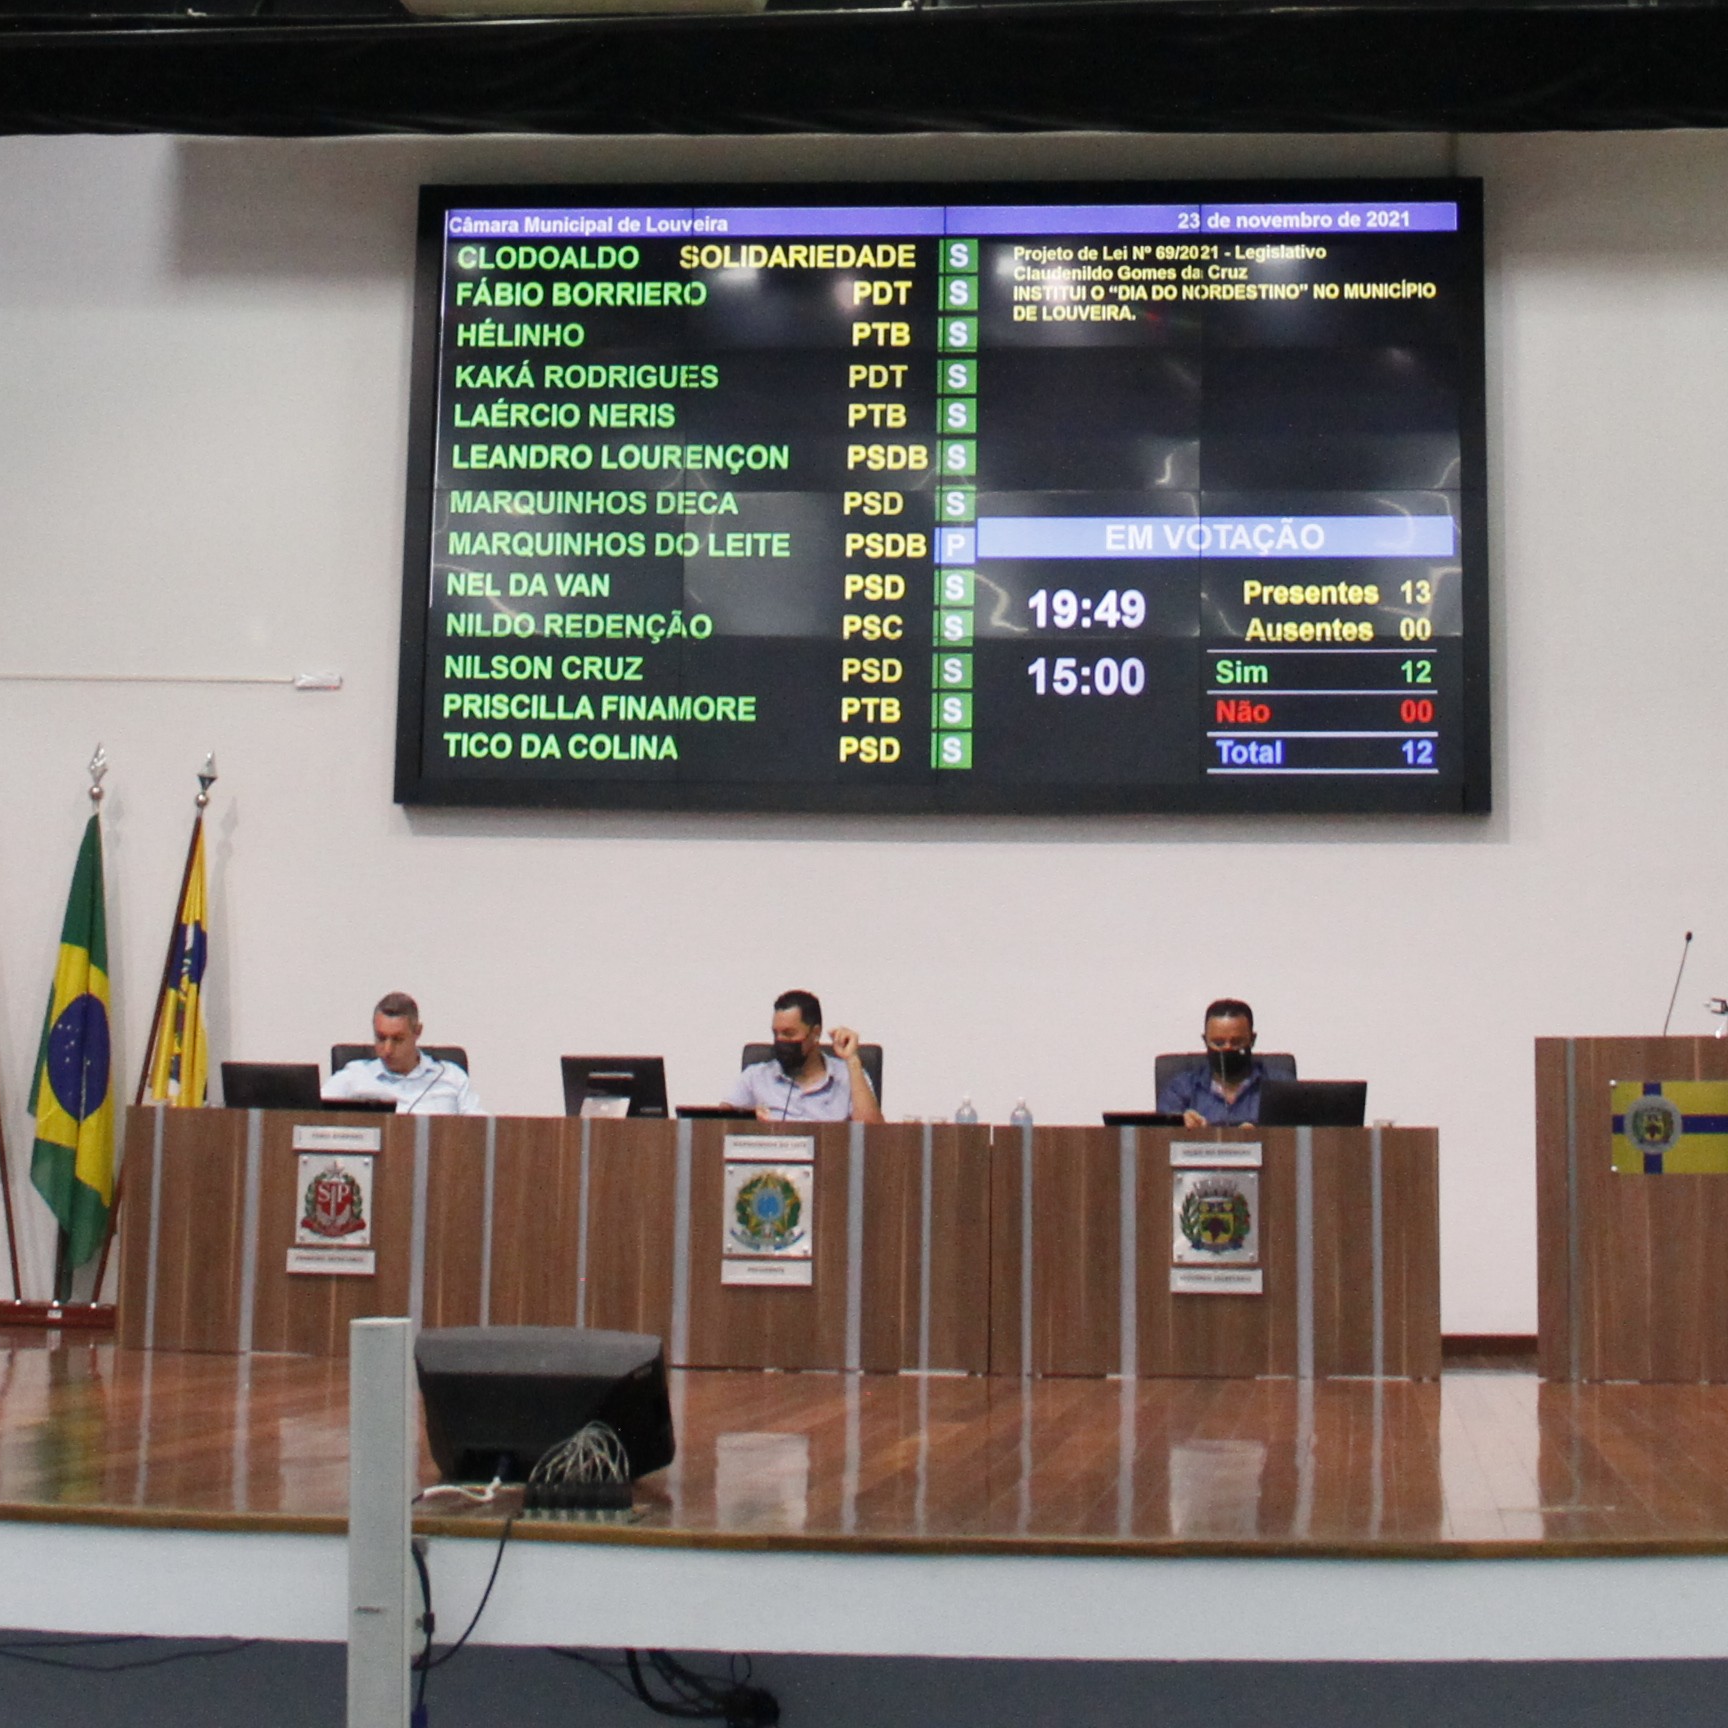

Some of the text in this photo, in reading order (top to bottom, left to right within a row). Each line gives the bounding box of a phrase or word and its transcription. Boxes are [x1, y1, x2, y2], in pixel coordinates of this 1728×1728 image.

[448, 215, 728, 236] Câmara Municipal de Louveira
[1178, 210, 1411, 228] 23 de novembro de 2021
[458, 244, 968, 270] CLODOALDO SOLIDARIEDADE S
[1014, 246, 1073, 264] Projeto
[1078, 246, 1098, 260] de
[1103, 246, 1127, 260] Lei
[1131, 246, 1151, 260] Nº
[1155, 245, 1218, 261] 69/2021
[1234, 244, 1327, 263] Legislativo
[1014, 265, 1248, 281] Claudenildo Gomes da Cruz
[456, 277, 968, 306] FÁBIO BORRIERO PDT S
[1014, 284, 1086, 301] INSTITUI
[1090, 284, 1106, 301] O
[1152, 284, 1177, 300] DO
[1313, 283, 1340, 299] NO
[1344, 280, 1436, 299] MUNICÍPIO
[1014, 305, 1136, 322] DE LOUVEIRA.
[457, 318, 968, 347] HÉLINHO PTB S
[455, 360, 967, 389] KAKÁ RODRIGUES PDT S
[454, 398, 966, 428] LAÉRCIO NERIS PTB S
[452, 444, 966, 475] LEANDRO LOURENÇON PSDB S
[450, 491, 966, 516] MARQUINHOS DECA PSD S
[448, 532, 965, 558] MARQUINHOS DO LEITE PSDB P
[1106, 517, 1326, 555] EM VOTAÇÃO
[446, 574, 964, 600] NEL DA VAN PSD S
[1244, 580, 1432, 606] Presentes 13
[1028, 590, 1146, 628] 19:49
[446, 610, 964, 643] NILDO REDENÇÃO PSC S
[1245, 618, 1432, 642] Ausentes 00
[444, 656, 962, 682] NILSON CRUZ PSD S
[1028, 657, 1146, 695] 15:00
[1216, 661, 1432, 684] Sim 12
[444, 694, 962, 722] PRISCILLA FINAMORE PTB S
[1216, 700, 1434, 724] Não 00
[444, 732, 962, 762] TICO DA COLINA PSD S
[1216, 740, 1434, 764] Total 12
